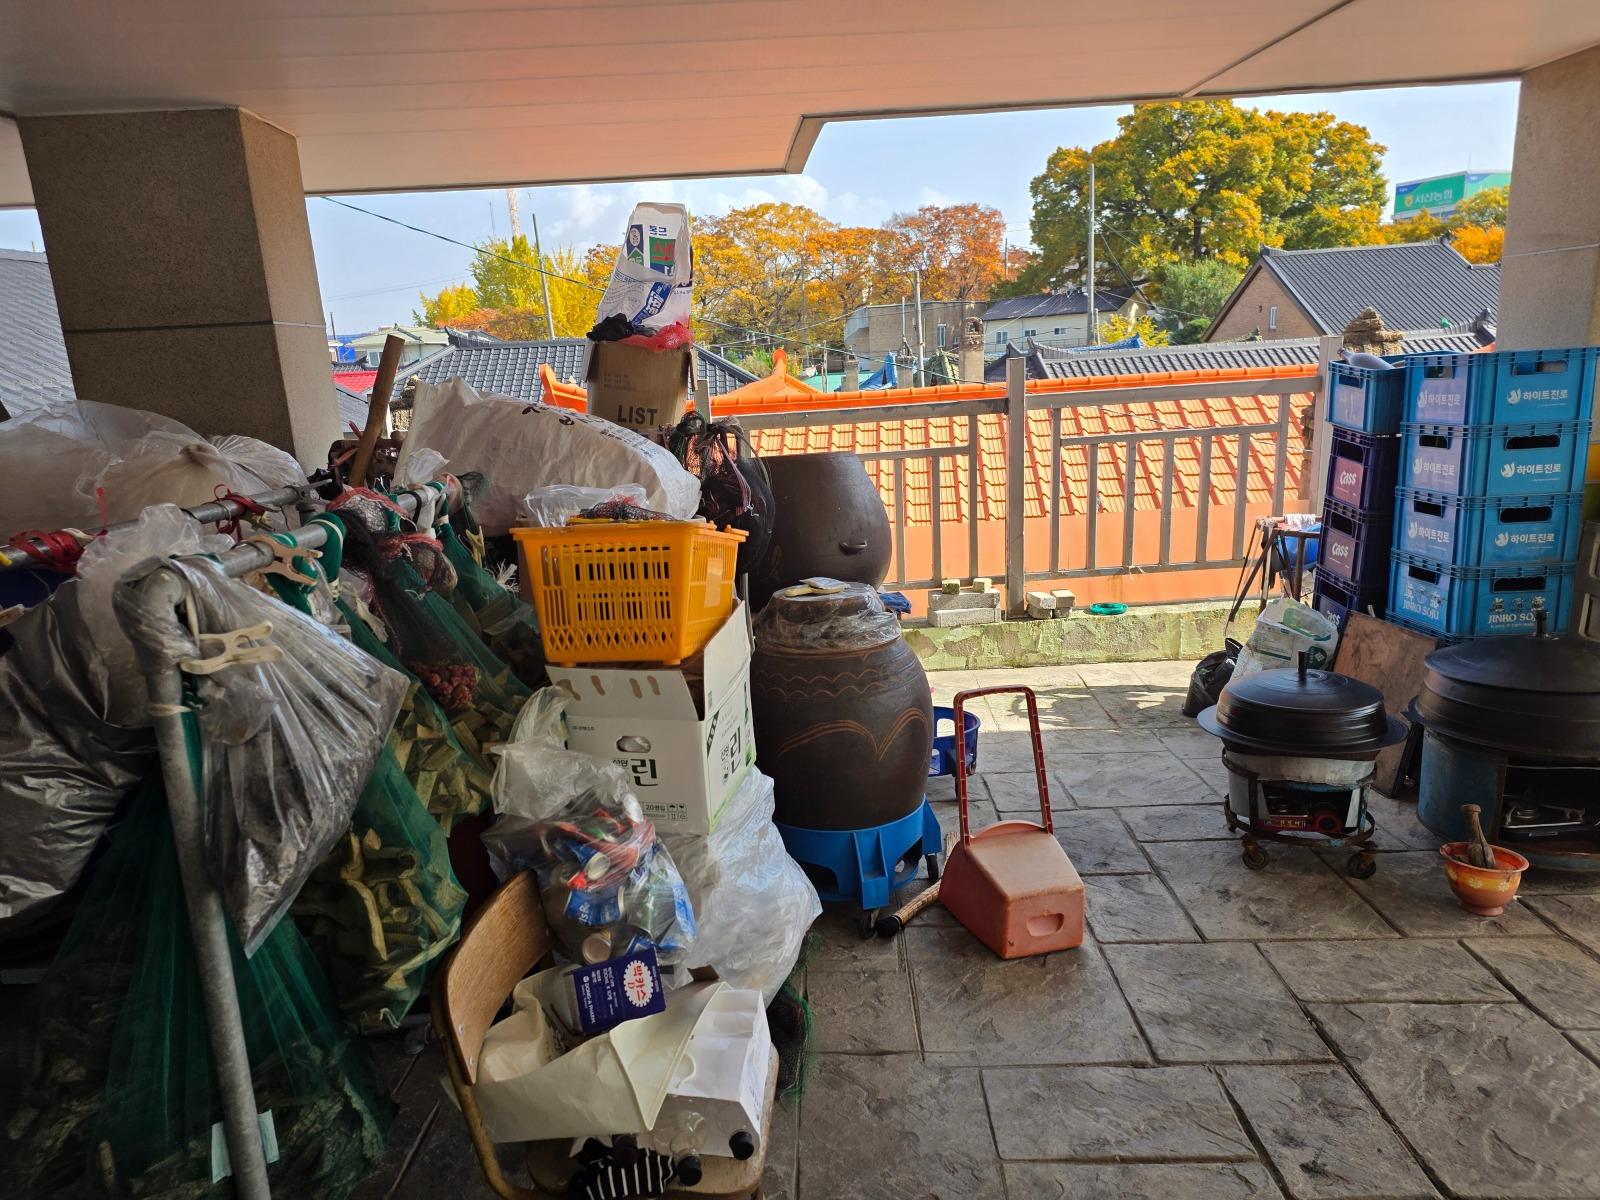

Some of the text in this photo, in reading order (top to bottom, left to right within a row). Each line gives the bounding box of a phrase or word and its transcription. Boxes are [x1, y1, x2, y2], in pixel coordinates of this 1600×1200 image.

[1428, 394, 1461, 407] 하이트진로
[1522, 389, 1568, 400] 하이트진로
[618, 405, 658, 426] LIST
[1423, 462, 1455, 476] 하이트진로
[1516, 463, 1561, 474] 하이트진로
[1340, 471, 1357, 485] Cass
[1419, 525, 1449, 543] 하이트진로
[1510, 533, 1555, 544] 하이트진로
[1332, 542, 1349, 557] Cass
[1327, 610, 1340, 625] ass
[1488, 613, 1517, 624] JINRO
[630, 759, 659, 787] 린
[633, 965, 647, 1001] 박카스
